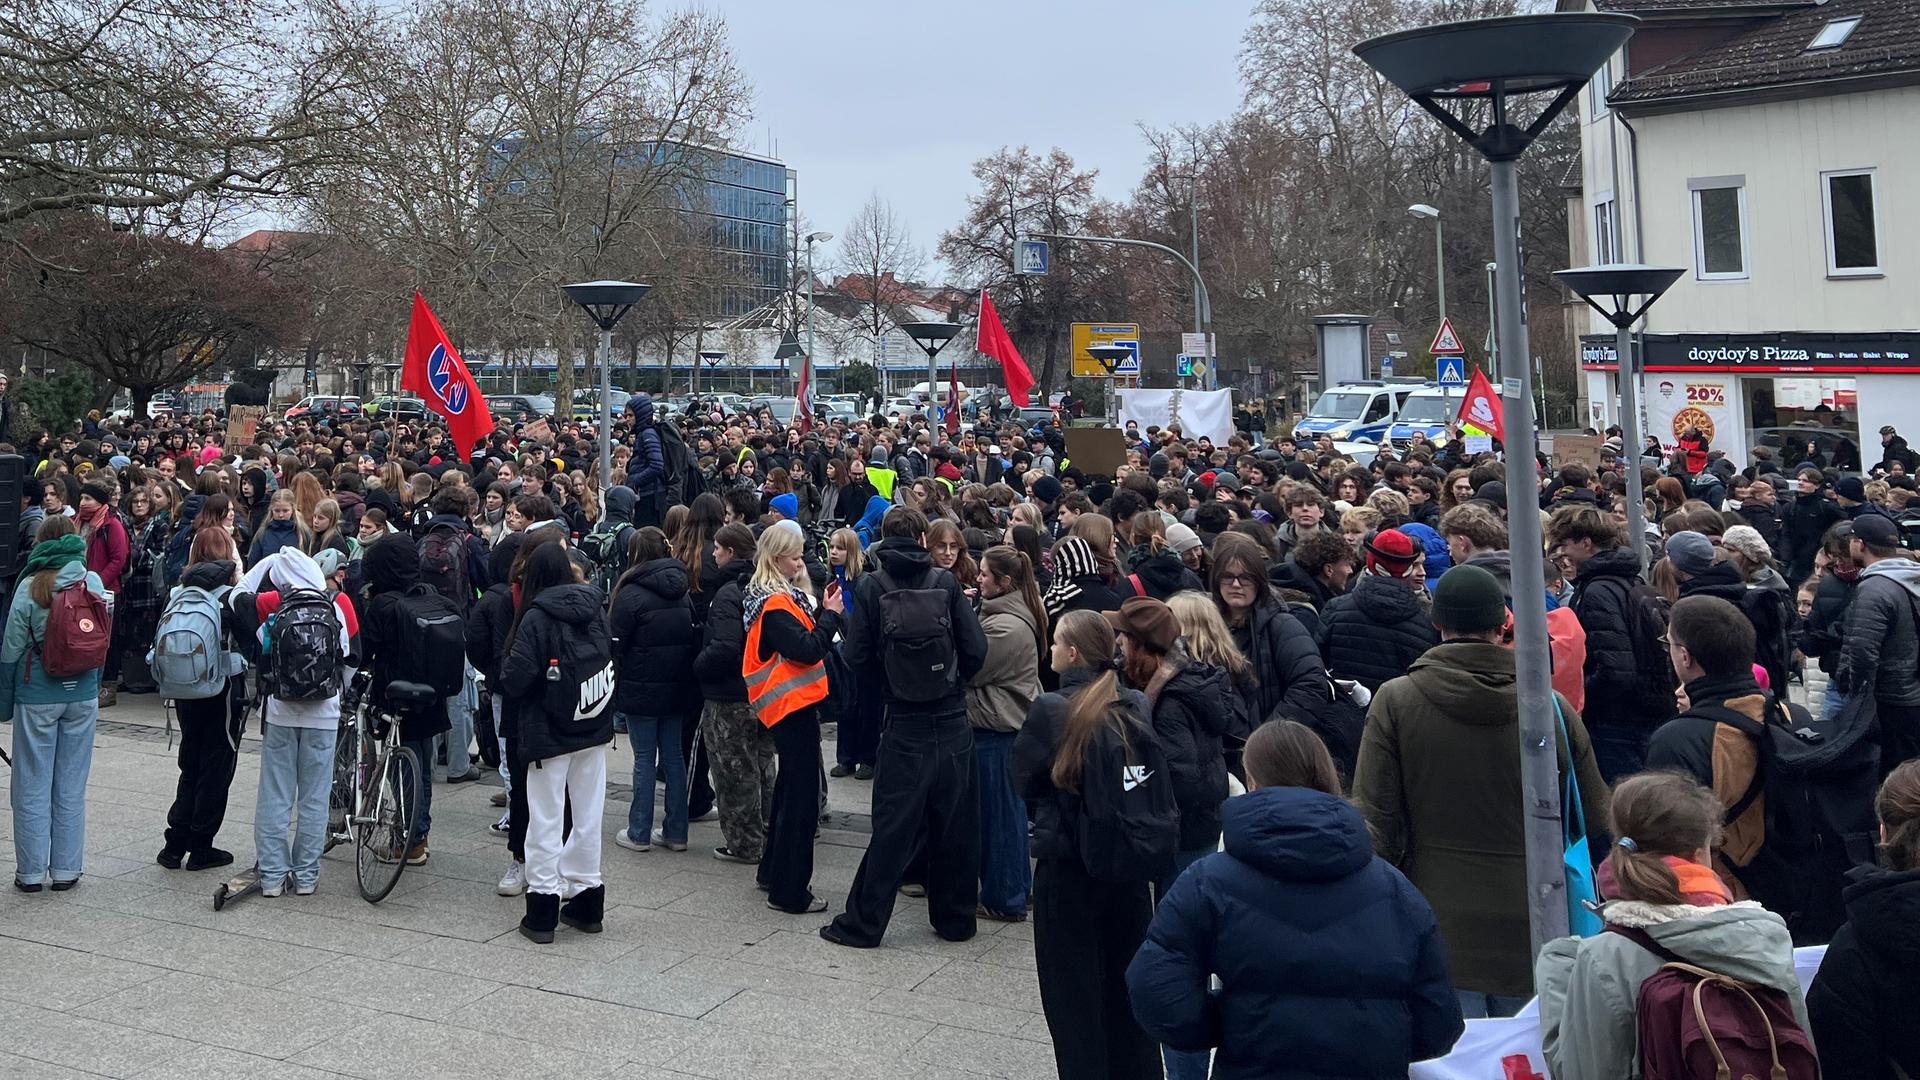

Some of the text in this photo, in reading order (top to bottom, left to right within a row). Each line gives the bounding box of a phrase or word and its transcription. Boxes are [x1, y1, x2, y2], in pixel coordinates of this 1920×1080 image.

[1688, 346, 1810, 364] doydoy's Pizza
[1885, 351, 1909, 360] Wraps
[1686, 387, 1724, 402] 20%
[580, 660, 615, 710] NIKE
[1123, 765, 1146, 781] NIKE
